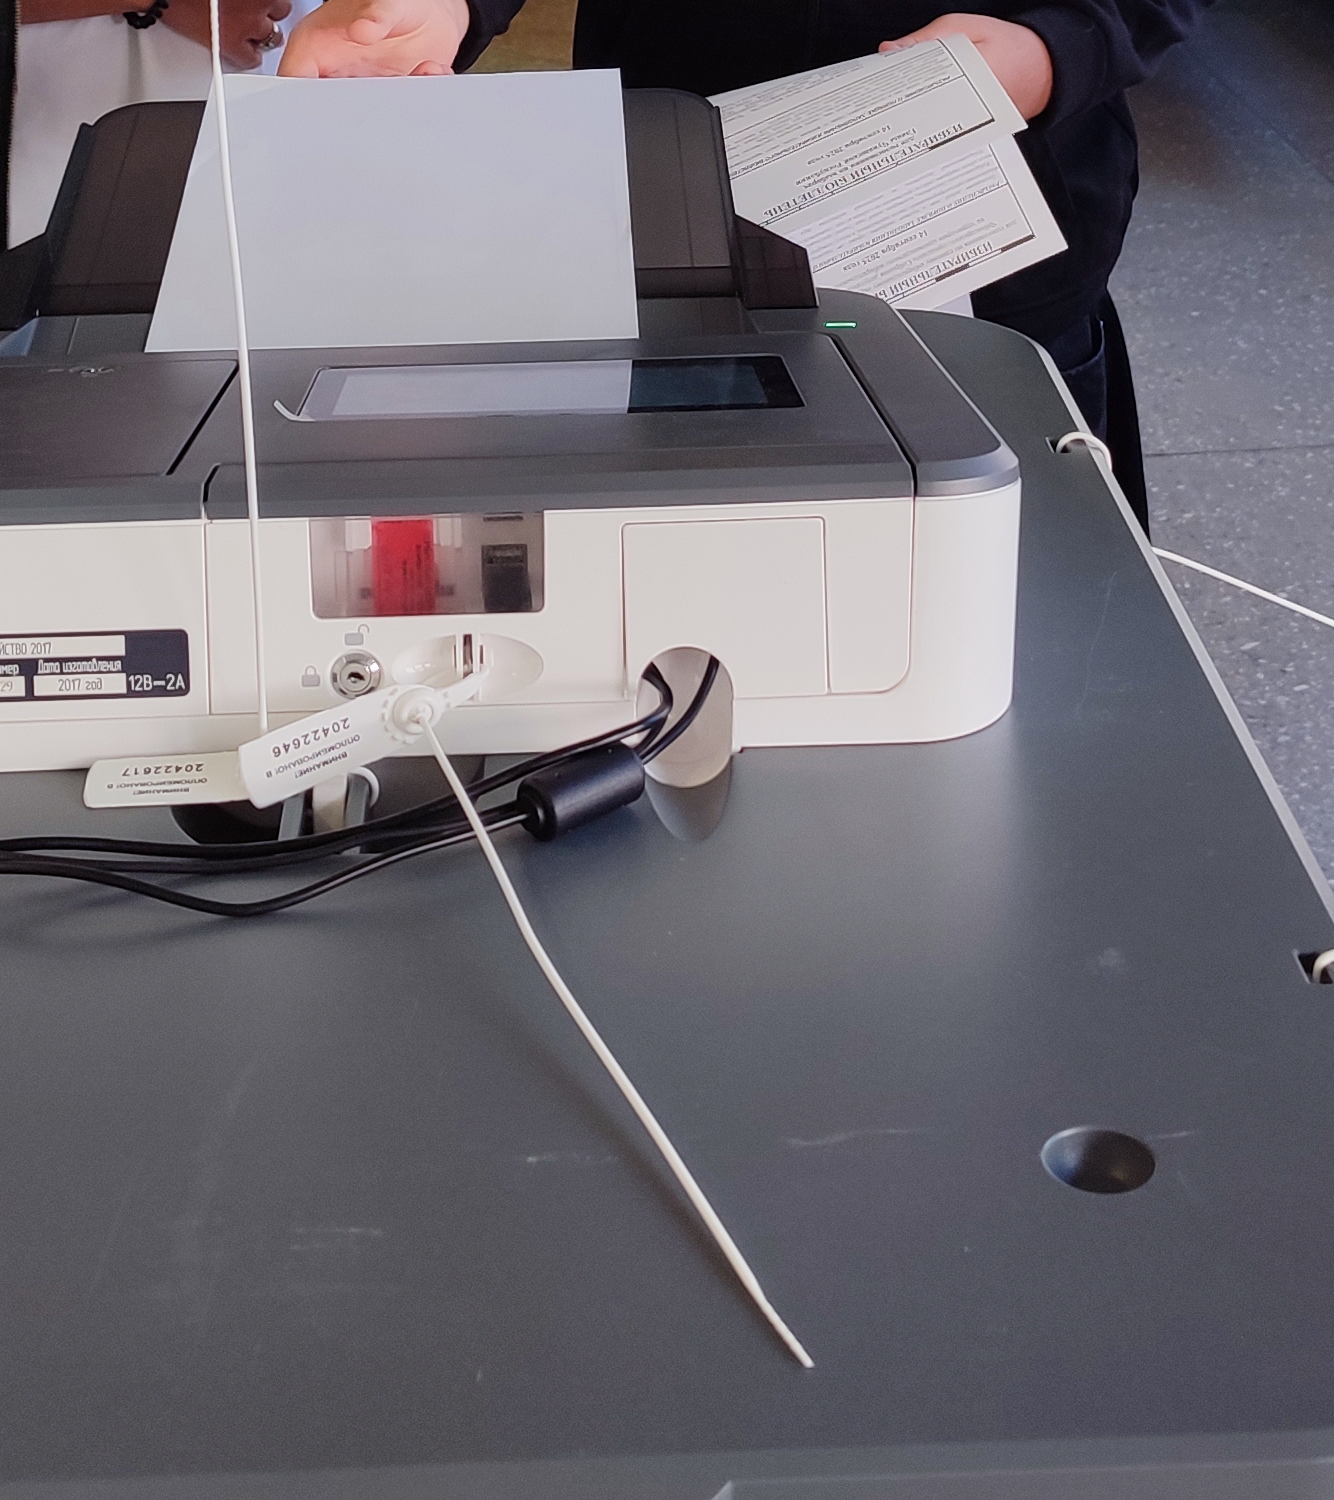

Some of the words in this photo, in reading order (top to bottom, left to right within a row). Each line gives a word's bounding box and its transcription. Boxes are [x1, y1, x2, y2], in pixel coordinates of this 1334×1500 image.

[30, 641, 53, 655] 2017
[37, 659, 61, 675] Дата
[62, 659, 123, 674] изготовления
[57, 678, 82, 692] 2017
[84, 677, 104, 691] год
[271, 716, 351, 759] 20422646
[273, 734, 361, 776] ОПЛОМБИРОВАНО!
[121, 762, 205, 777] 20422617
[294, 751, 348, 779] ВНИМАНИЕ!
